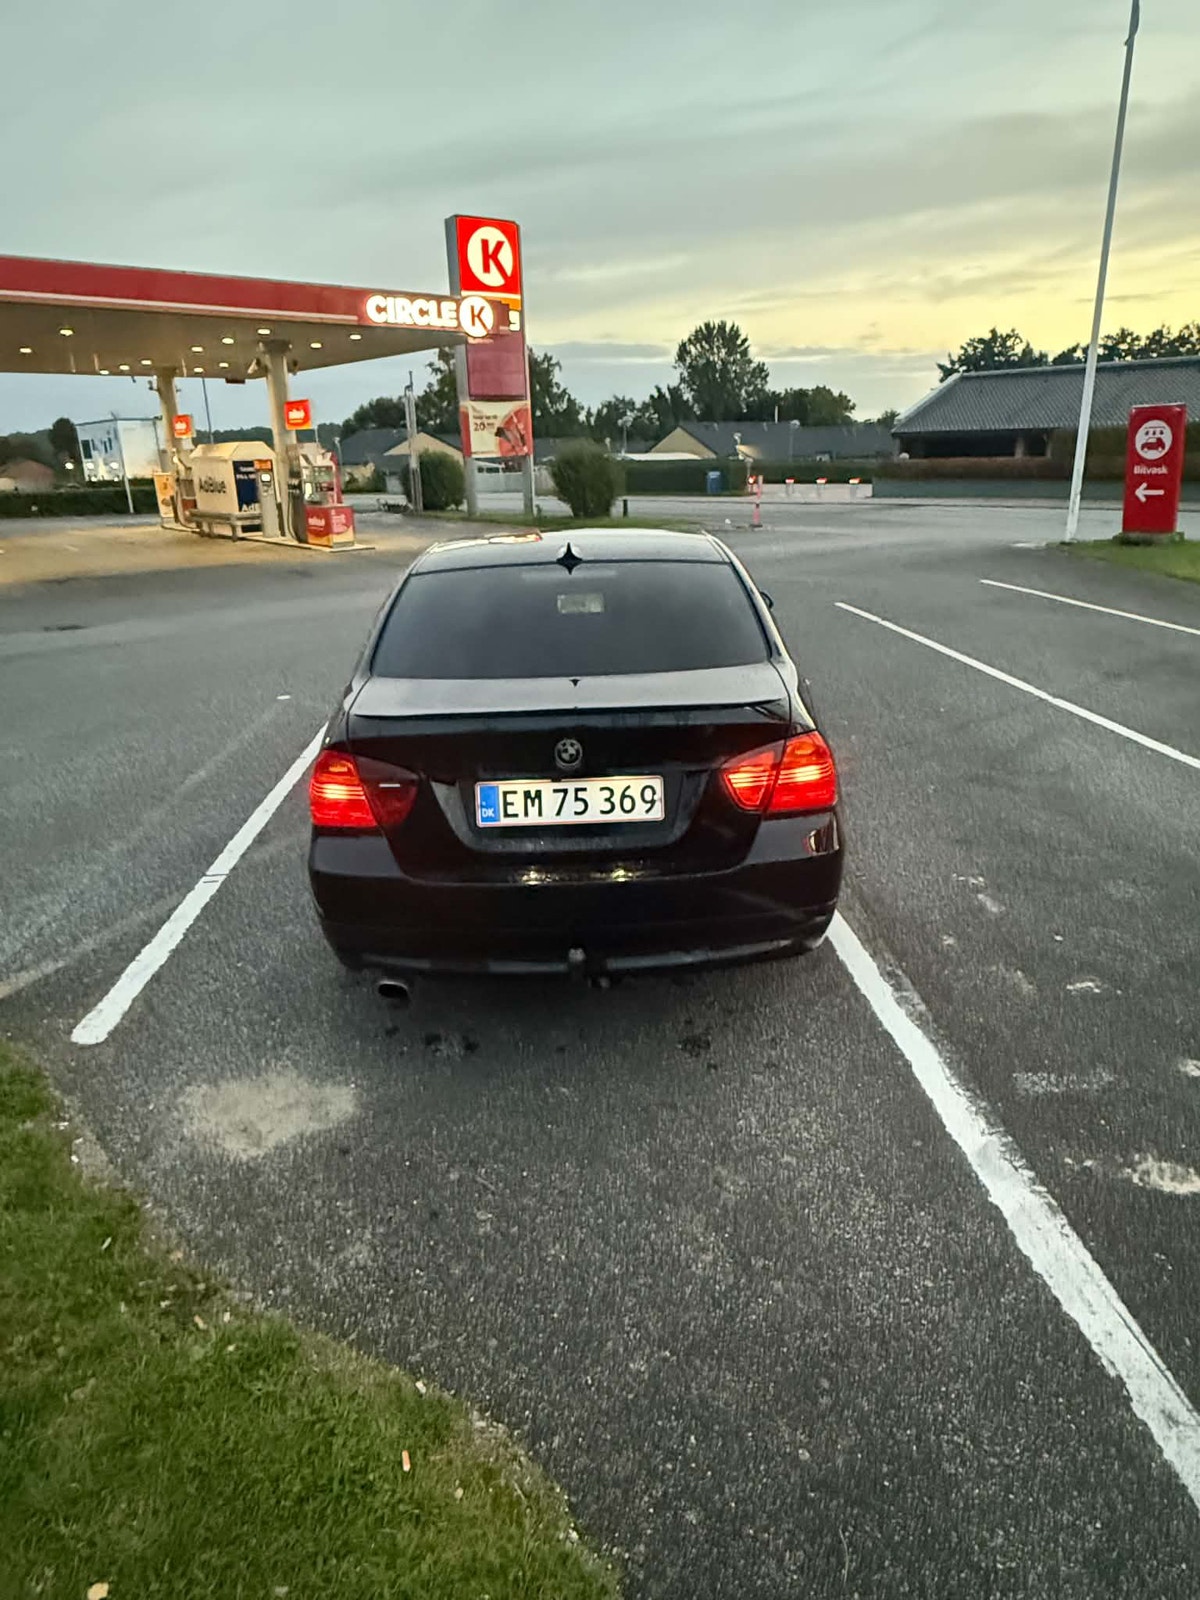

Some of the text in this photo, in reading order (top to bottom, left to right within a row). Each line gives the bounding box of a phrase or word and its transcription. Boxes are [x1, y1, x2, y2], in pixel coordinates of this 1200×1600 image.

[479, 238, 511, 284] K
[366, 295, 459, 328] CIRCLE
[482, 808, 495, 818] DK
[502, 785, 657, 818] EM 75 369
